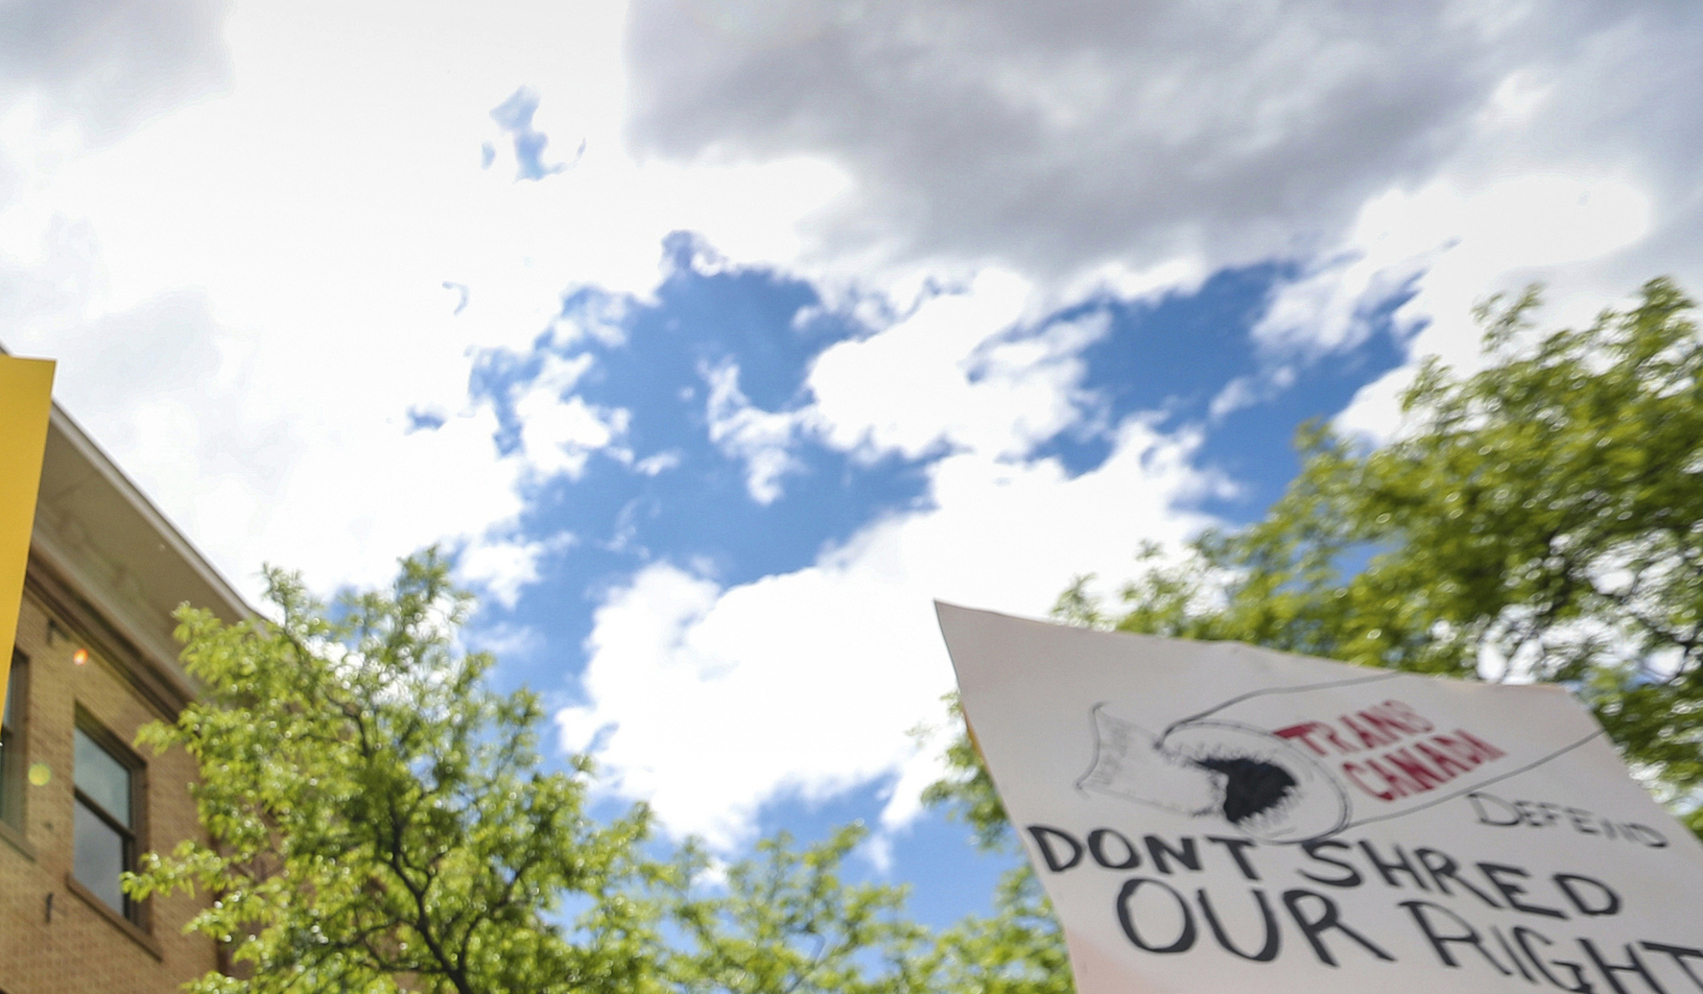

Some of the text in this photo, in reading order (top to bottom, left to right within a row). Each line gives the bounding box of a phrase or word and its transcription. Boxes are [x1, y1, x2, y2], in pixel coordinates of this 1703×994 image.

[1272, 699, 1435, 757] TRANS
[1342, 729, 1508, 801] CANADA
[1467, 791, 1669, 848] DEFEND
[1027, 825, 1623, 920] DONT SHRED
[1116, 878, 1398, 968] OUR
